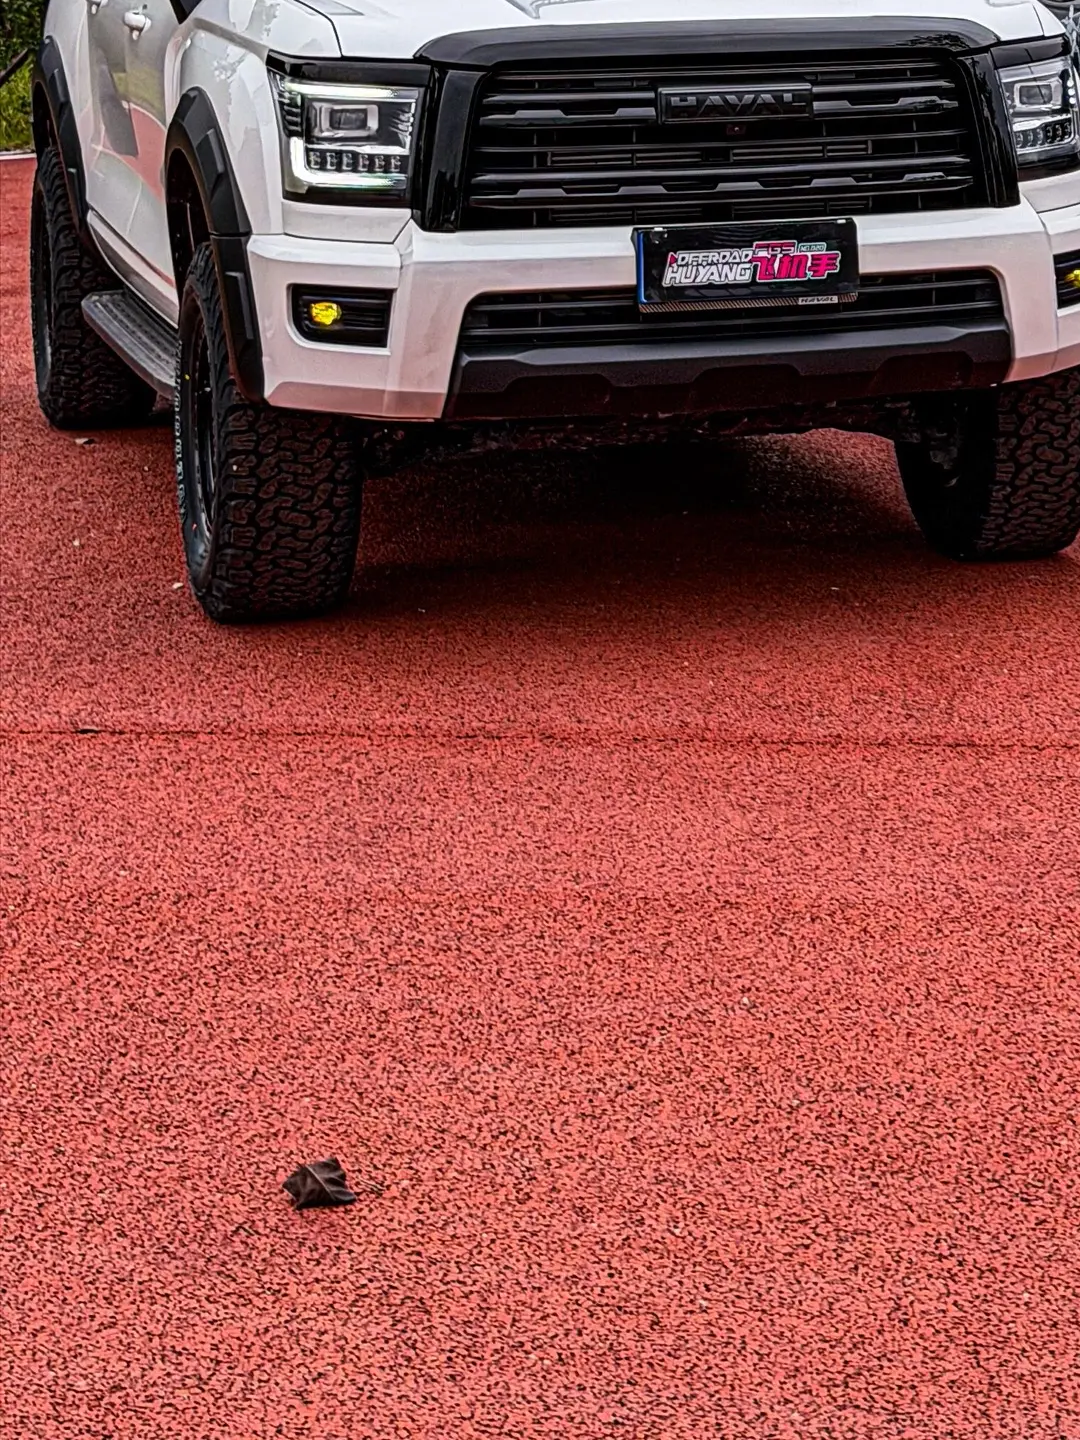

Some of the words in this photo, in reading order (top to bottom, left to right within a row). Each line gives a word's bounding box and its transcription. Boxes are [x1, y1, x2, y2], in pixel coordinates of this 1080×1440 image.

[669, 92, 807, 118] HAVAL
[677, 250, 754, 265] OFFROAD
[748, 253, 840, 281] 飞机手
[665, 262, 752, 284] HUYANG
